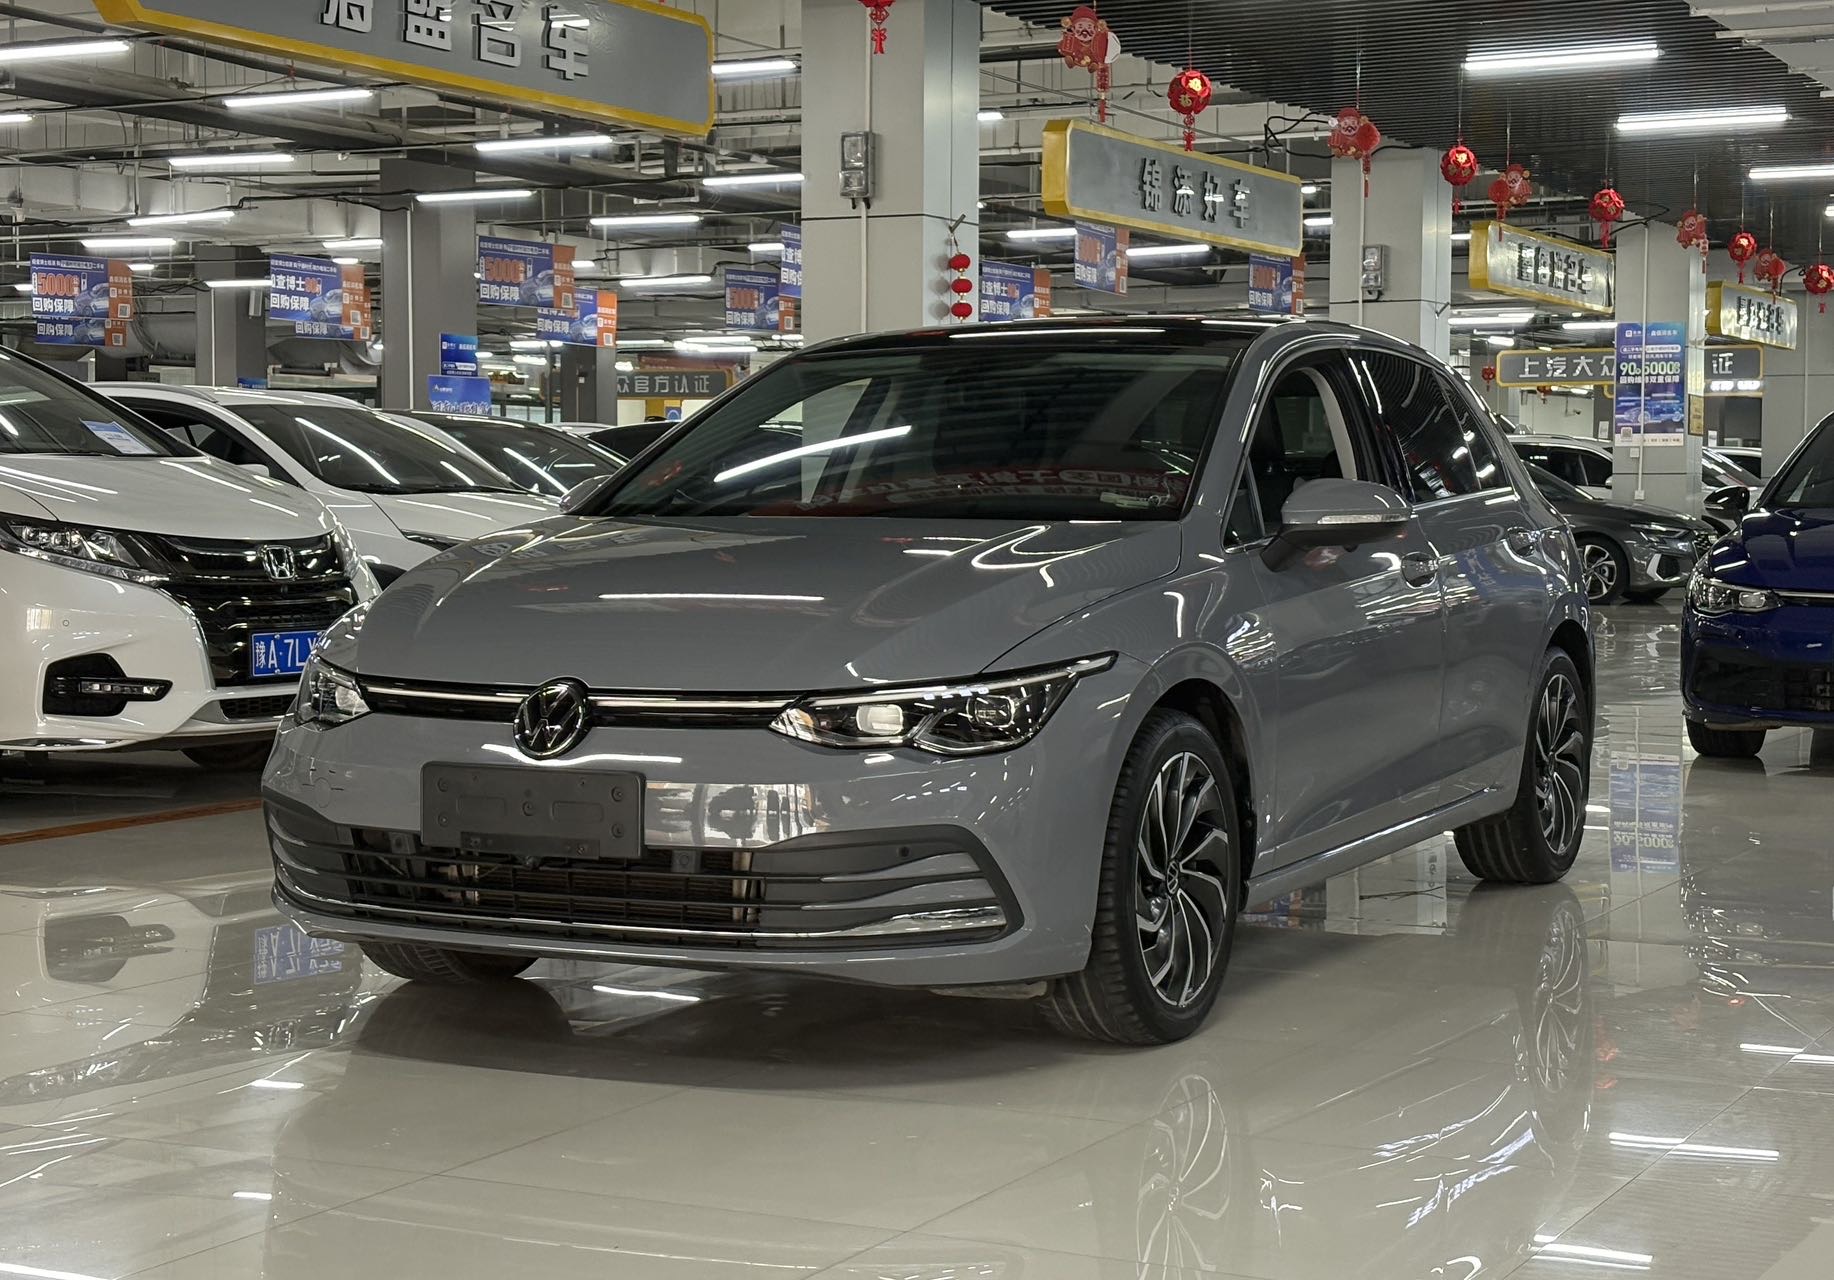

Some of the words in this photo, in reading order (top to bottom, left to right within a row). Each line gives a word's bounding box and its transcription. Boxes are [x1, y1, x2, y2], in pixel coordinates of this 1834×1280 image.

[480, 283, 520, 302] 回购保障
[32, 297, 74, 313] 回购保障
[270, 293, 310, 311] 回购保障
[37, 322, 73, 336] 回购保障
[1519, 355, 1615, 378] 上汽大众
[1712, 352, 1734, 374] 证
